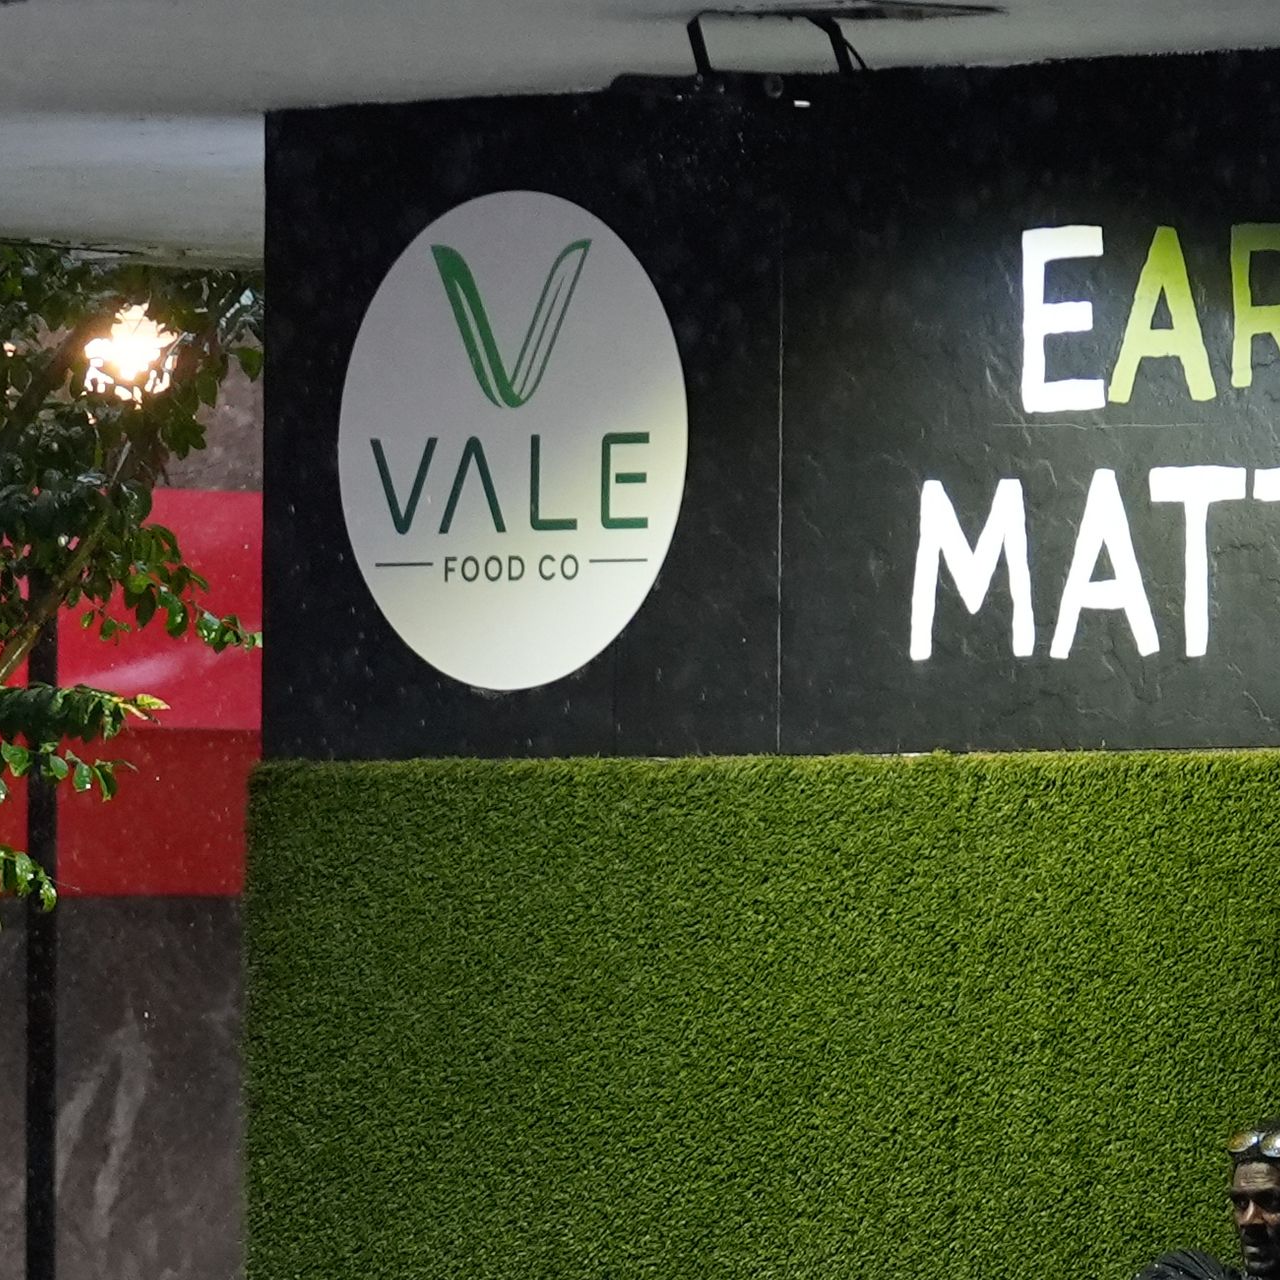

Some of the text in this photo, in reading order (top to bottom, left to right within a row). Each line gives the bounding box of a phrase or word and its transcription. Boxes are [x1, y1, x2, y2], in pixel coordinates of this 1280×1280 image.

[370, 431, 650, 535] VALE
[443, 554, 580, 582] FOOD CO
